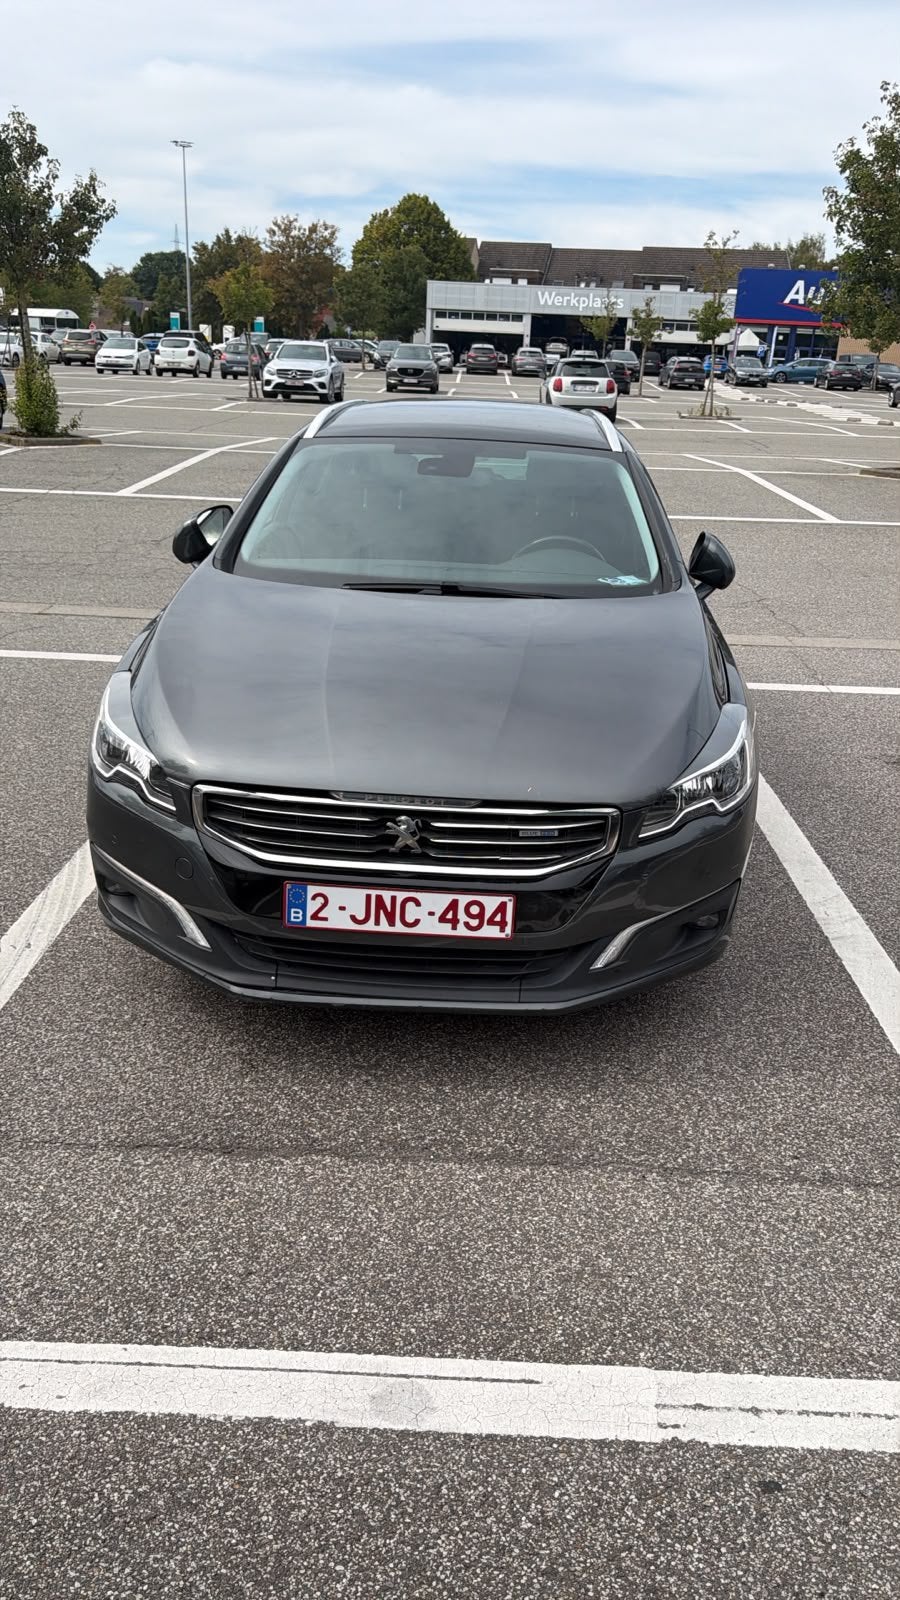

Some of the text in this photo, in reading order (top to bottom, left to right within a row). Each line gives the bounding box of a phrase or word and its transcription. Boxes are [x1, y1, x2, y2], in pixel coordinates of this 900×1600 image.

[783, 280, 828, 305] Au
[290, 908, 303, 922] B
[310, 892, 508, 933] 2-JNC-494
